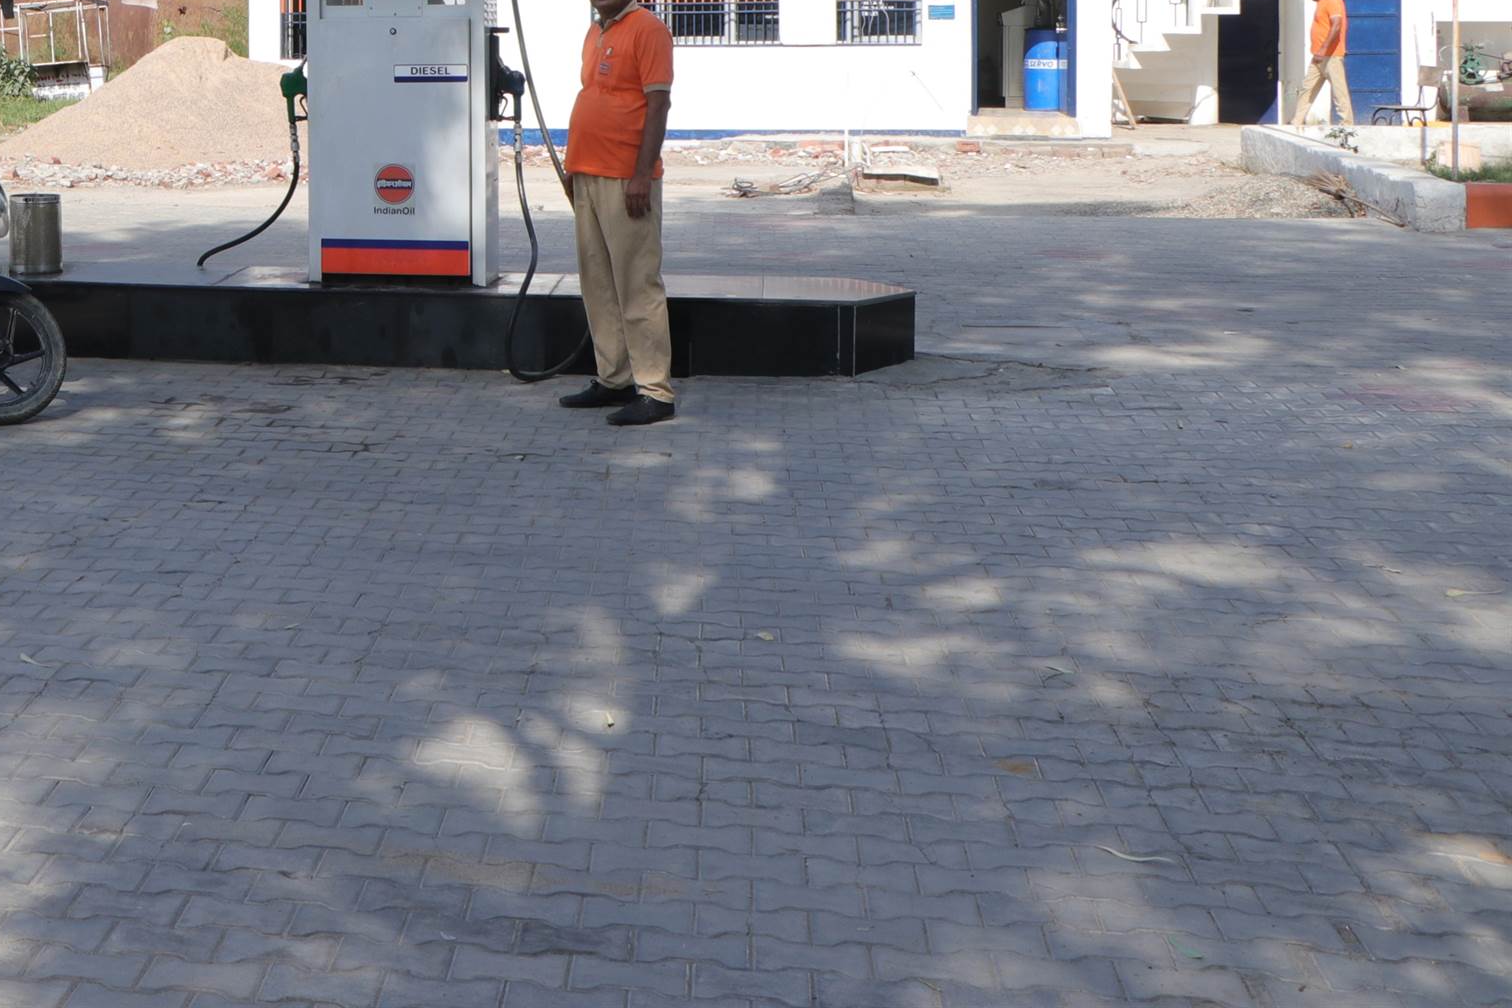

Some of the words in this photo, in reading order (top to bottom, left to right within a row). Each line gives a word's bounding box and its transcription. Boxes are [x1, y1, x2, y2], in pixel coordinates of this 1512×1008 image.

[1029, 59, 1055, 68] SERVO
[410, 66, 451, 75] DIESEL
[373, 206, 415, 215] IndianOil
